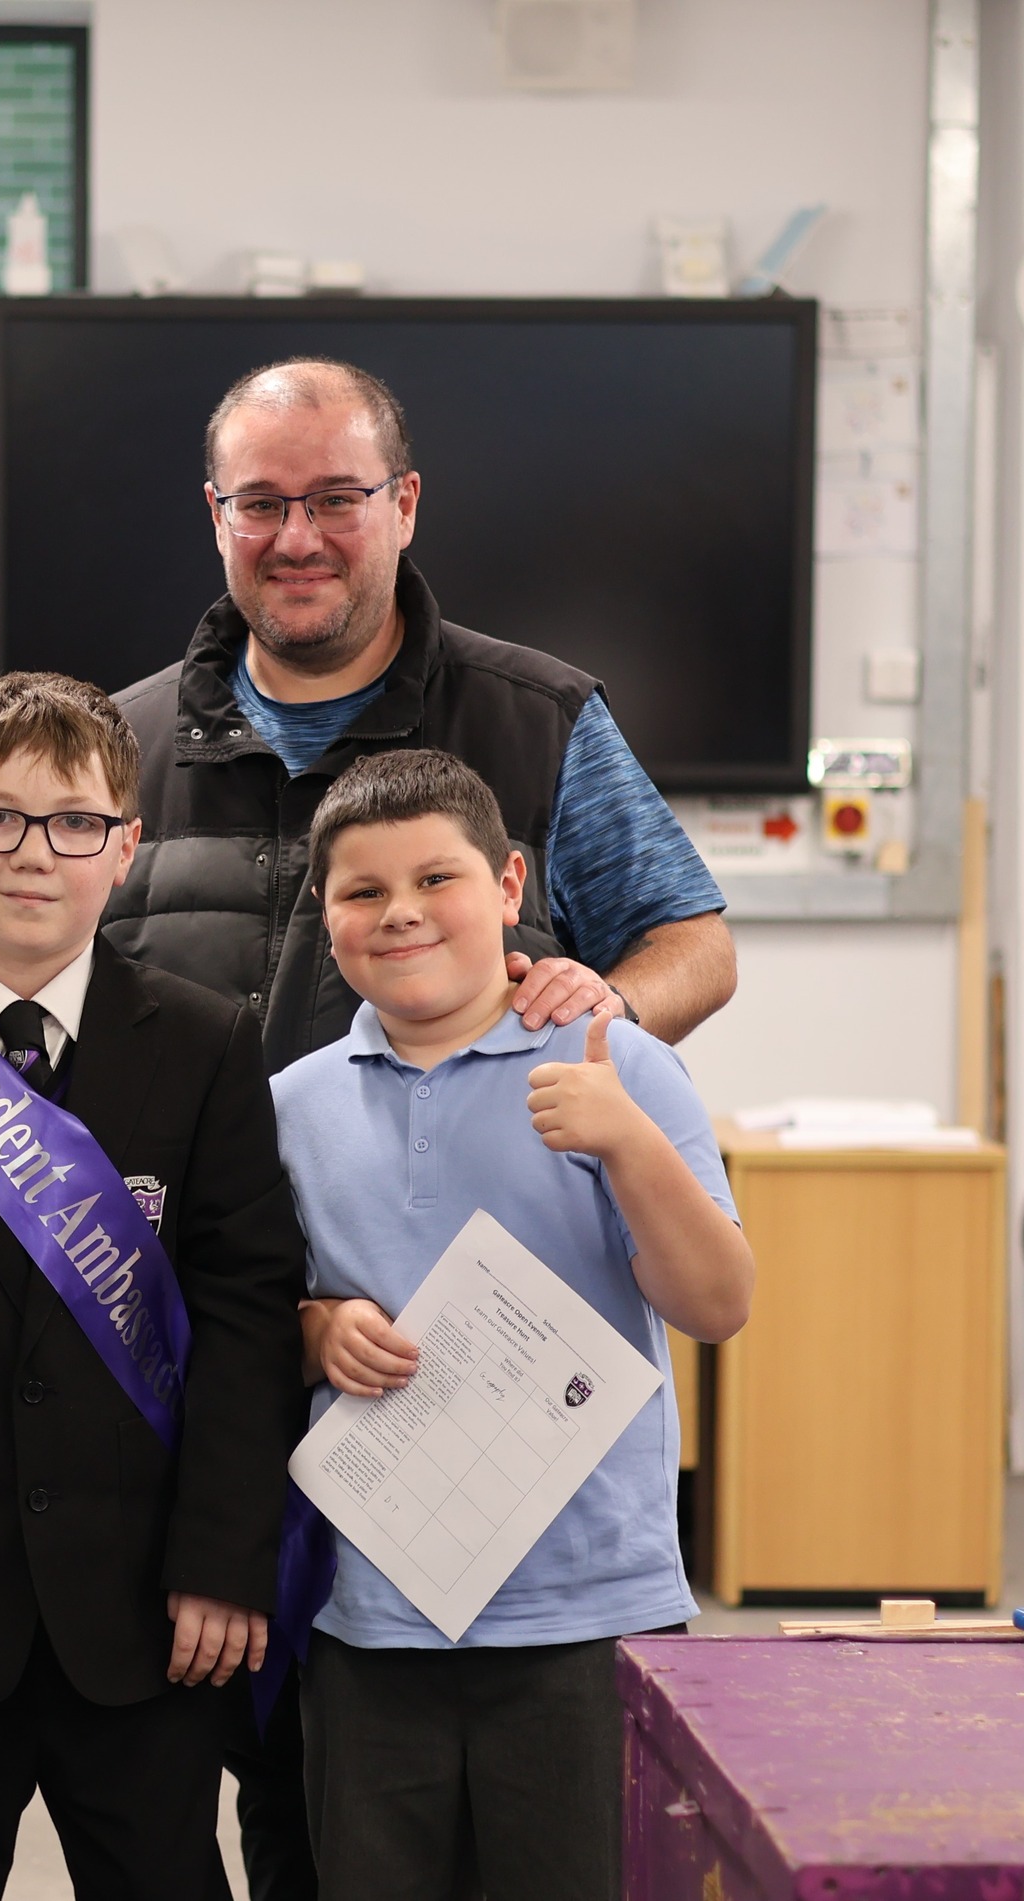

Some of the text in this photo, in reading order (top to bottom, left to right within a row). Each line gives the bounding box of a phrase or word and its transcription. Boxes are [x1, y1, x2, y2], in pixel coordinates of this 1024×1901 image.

[475, 1259, 491, 1274] Name
[491, 1288, 548, 1342] Gateacre Open Evening
[495, 1307, 530, 1342] Treasure Hunt
[541, 1318, 558, 1335] School
[473, 1304, 536, 1365] Learn our Gateacre Values!
